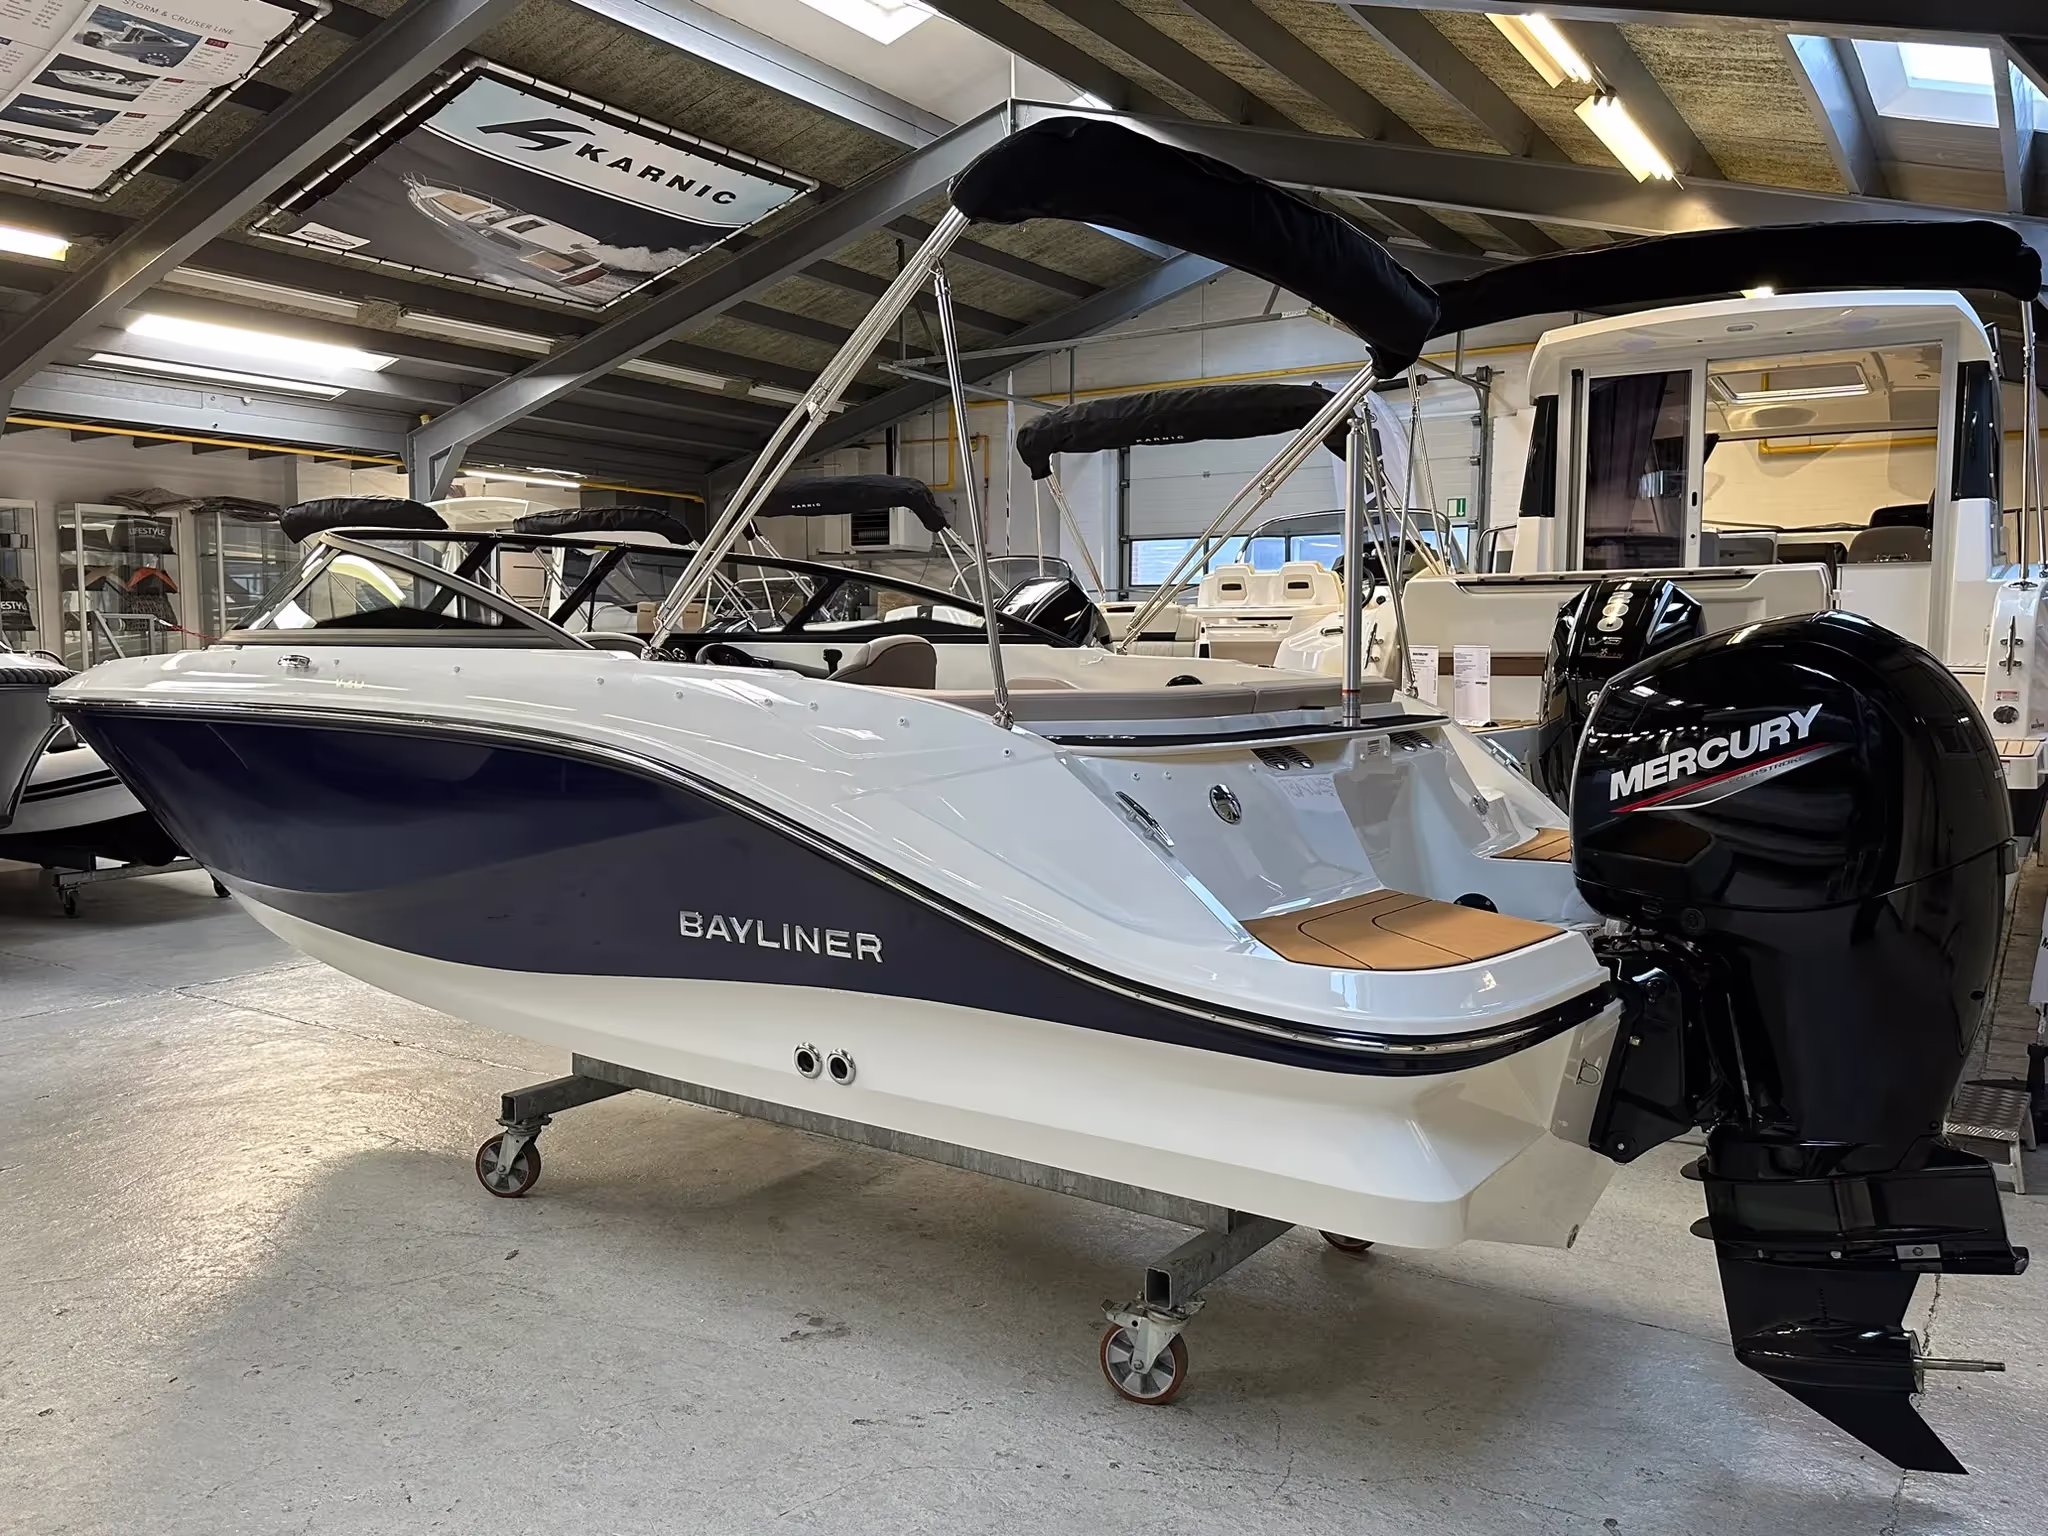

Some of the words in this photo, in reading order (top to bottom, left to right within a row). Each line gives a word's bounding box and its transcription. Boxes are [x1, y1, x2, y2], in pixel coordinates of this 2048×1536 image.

[122, 0, 159, 13] STORM
[171, 13, 213, 31] CRUISER
[213, 25, 234, 36] LINE
[574, 142, 737, 205] KARNIC
[129, 526, 166, 537] LIFESTYLE
[1609, 703, 1823, 801] MERCURY
[1727, 755, 1805, 785] FOURSTROKE
[679, 910, 884, 963] BAYLINER
